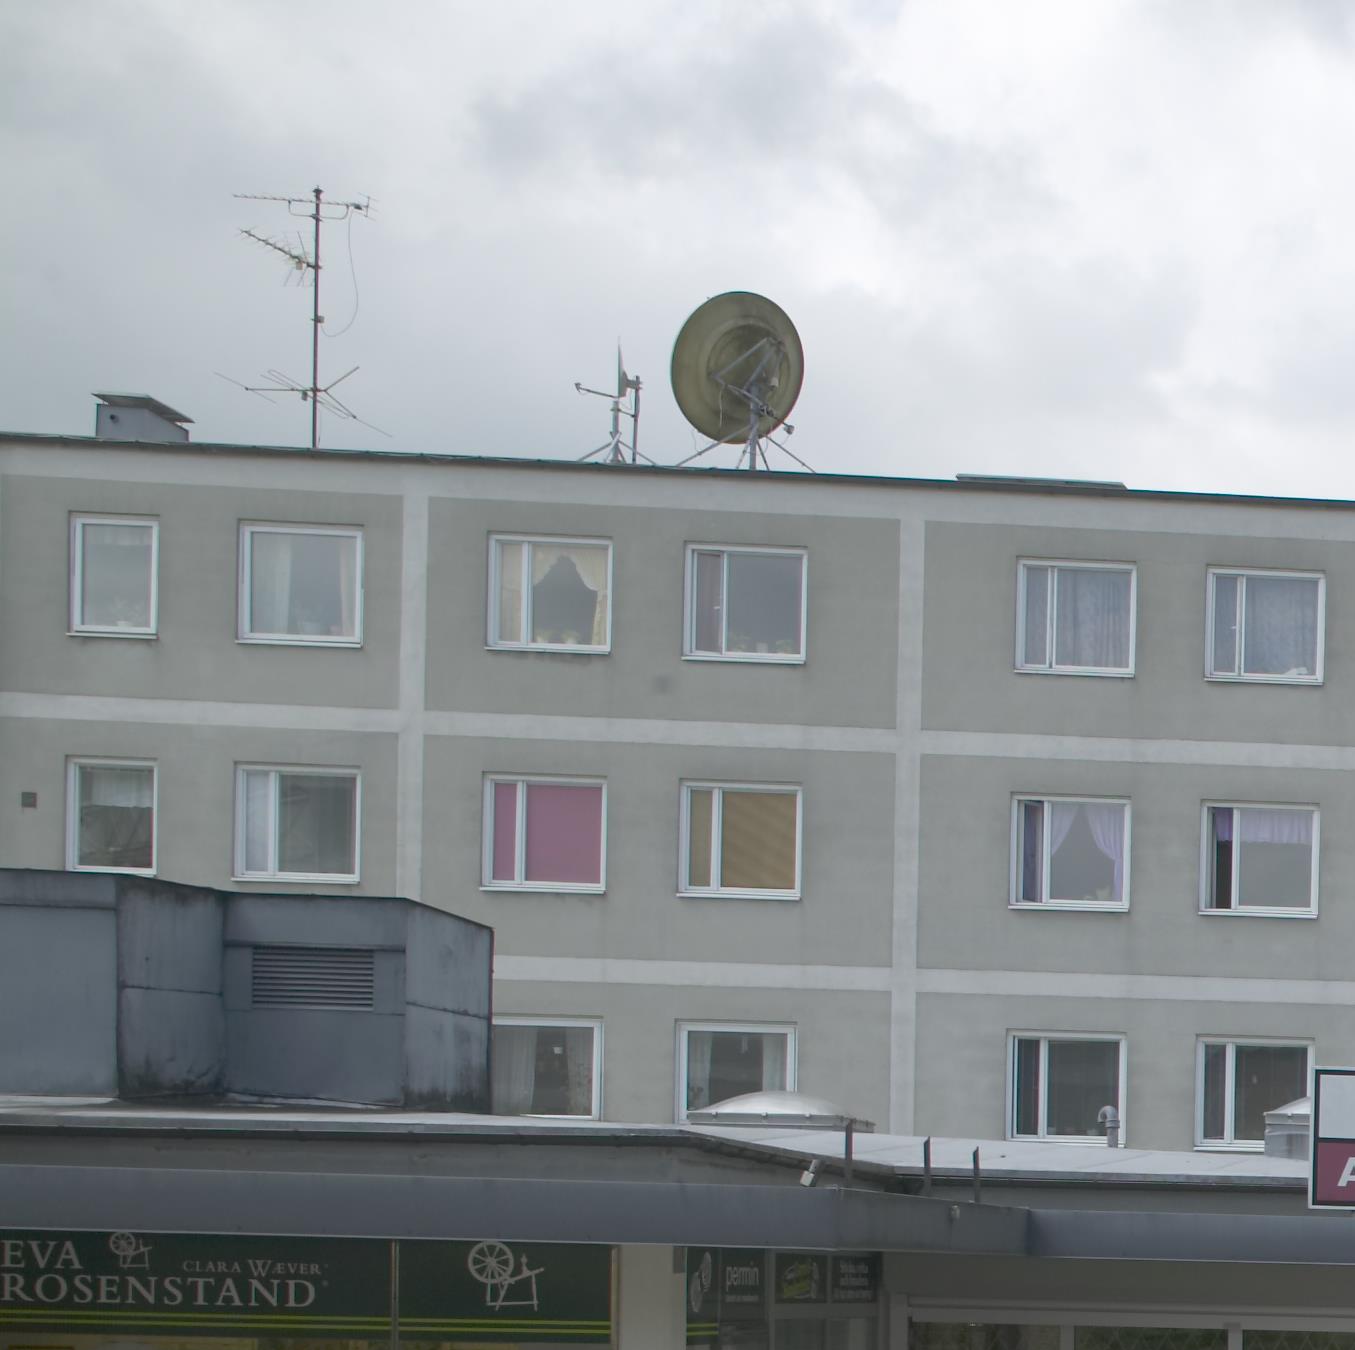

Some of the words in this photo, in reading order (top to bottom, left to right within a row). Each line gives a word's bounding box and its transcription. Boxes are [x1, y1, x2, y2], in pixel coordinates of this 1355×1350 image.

[1, 1239, 83, 1270] EVA
[182, 1258, 241, 1275] CLARA
[0, 1273, 317, 1309] ROSENSTAND
